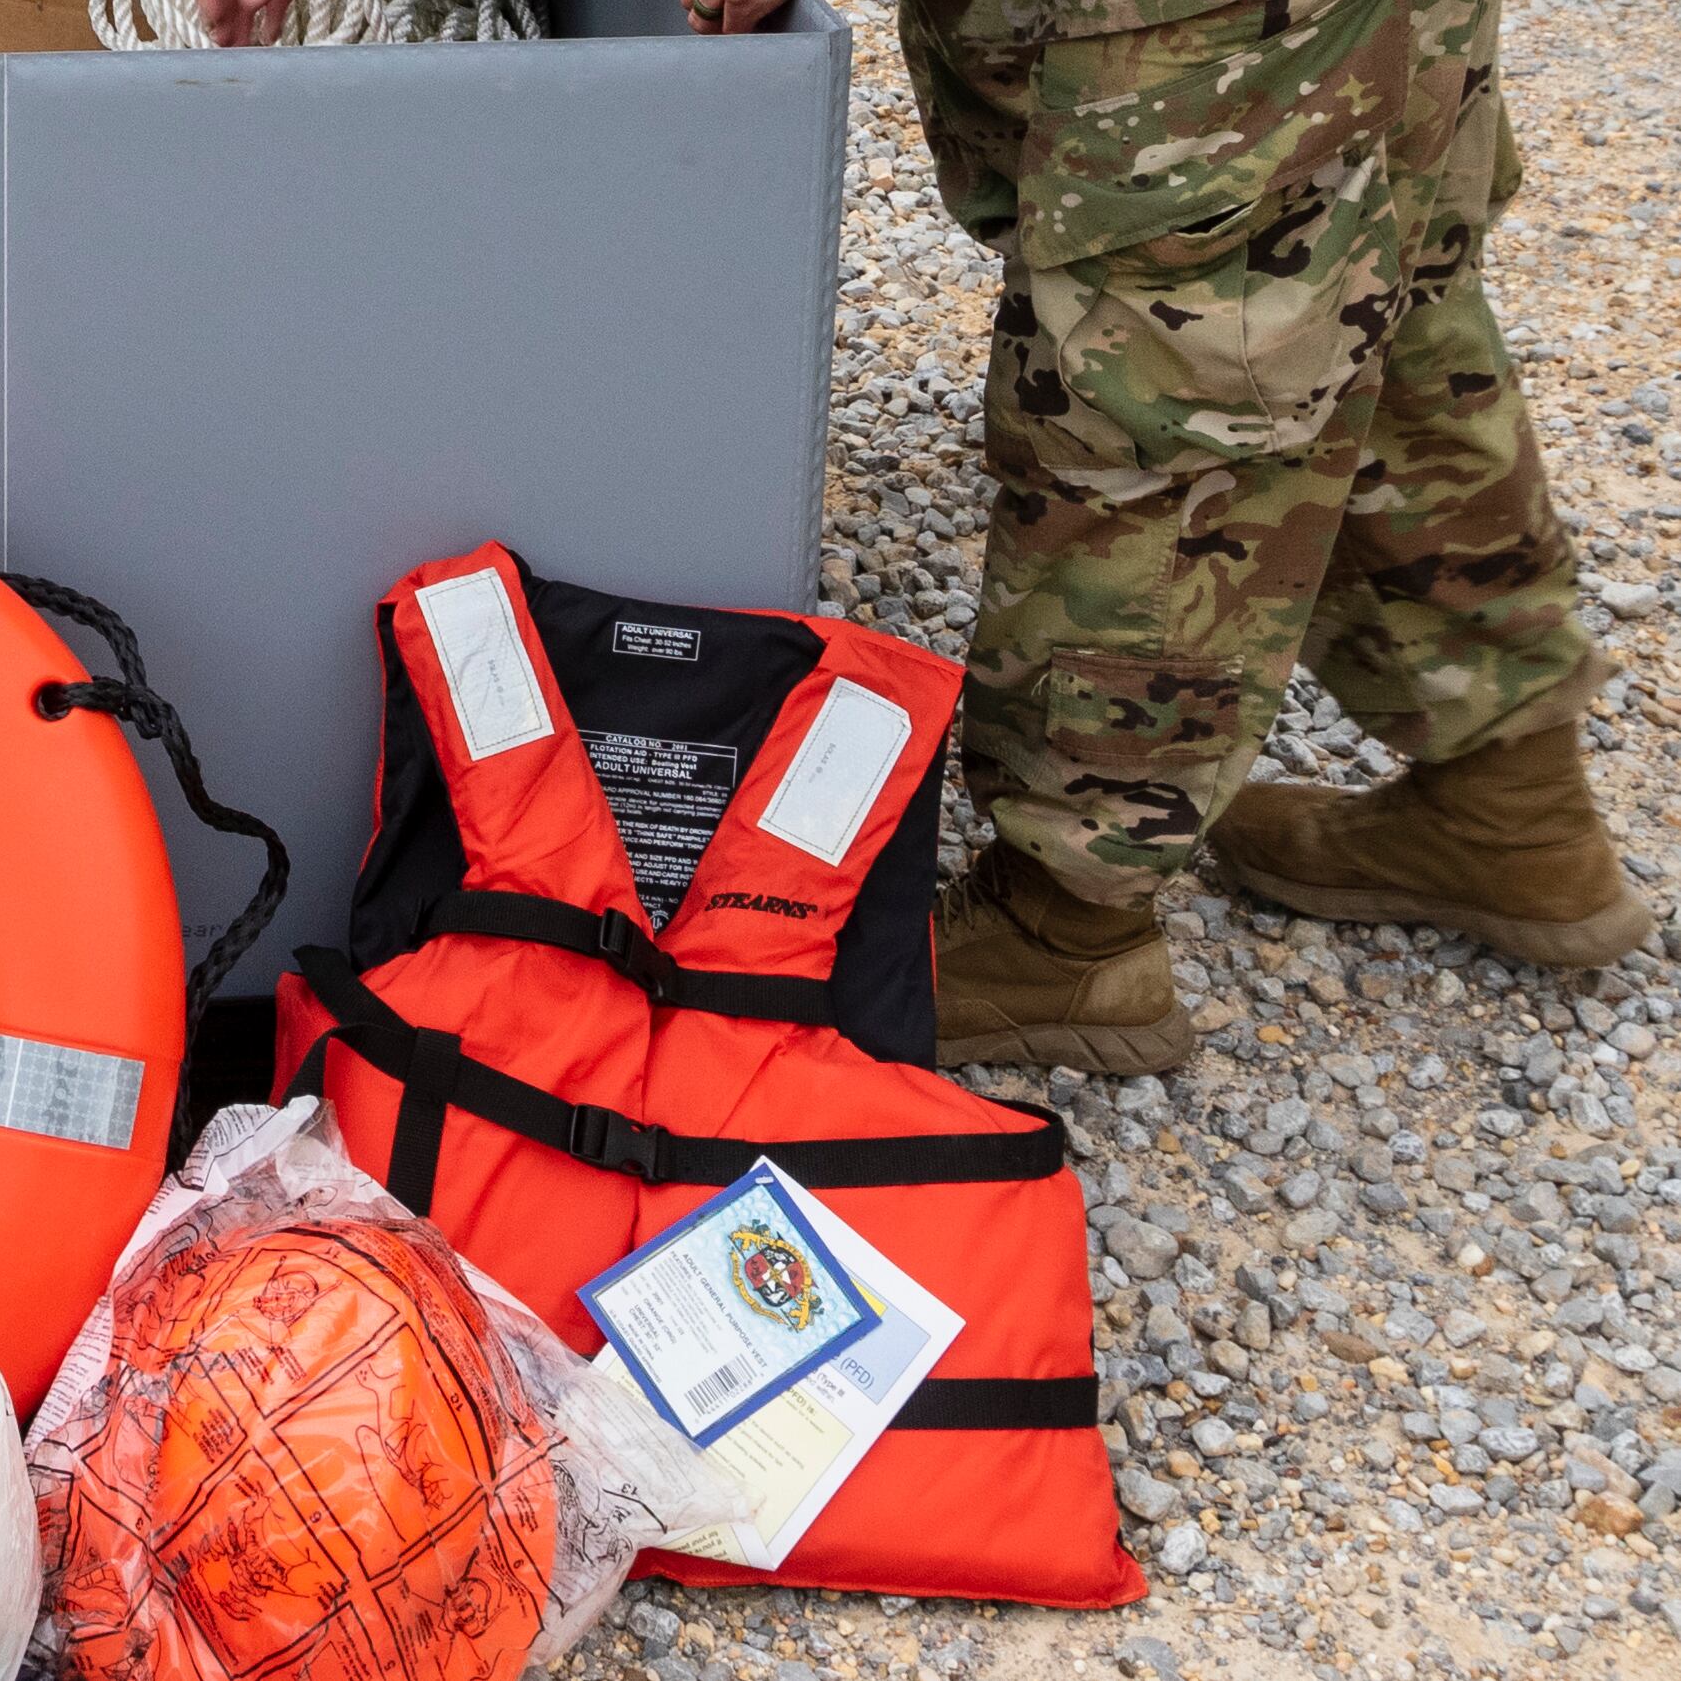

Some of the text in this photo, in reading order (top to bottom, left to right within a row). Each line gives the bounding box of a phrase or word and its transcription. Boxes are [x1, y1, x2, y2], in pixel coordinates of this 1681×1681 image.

[621, 625, 694, 639] ADULT UNIVERSAL
[605, 734, 647, 746] CATALOG
[589, 743, 632, 754] FLOTATION
[653, 751, 671, 759] TYPE
[682, 754, 698, 762] PFD
[588, 751, 628, 763] INTENDED
[651, 759, 679, 769] Boating
[680, 762, 697, 770] Vest
[594, 760, 630, 772] ADULT
[631, 764, 692, 779] UNIVERSAL
[652, 790, 681, 800] NUMBER
[658, 824, 679, 832] DEATH
[638, 837, 684, 848] AND PERFORM
[642, 861, 667, 870] ADJUST
[663, 855, 677, 863] PFD
[661, 871, 678, 879] CARE
[704, 889, 810, 920] STEARNS
[681, 1251, 767, 1370] ADULT GENERAL PURPOSE VEST
[836, 1354, 878, 1391] (PFD)
[814, 1370, 840, 1392] (Type
[620, 1482, 638, 1496] 13
[383, 1659, 396, 1672] 5
